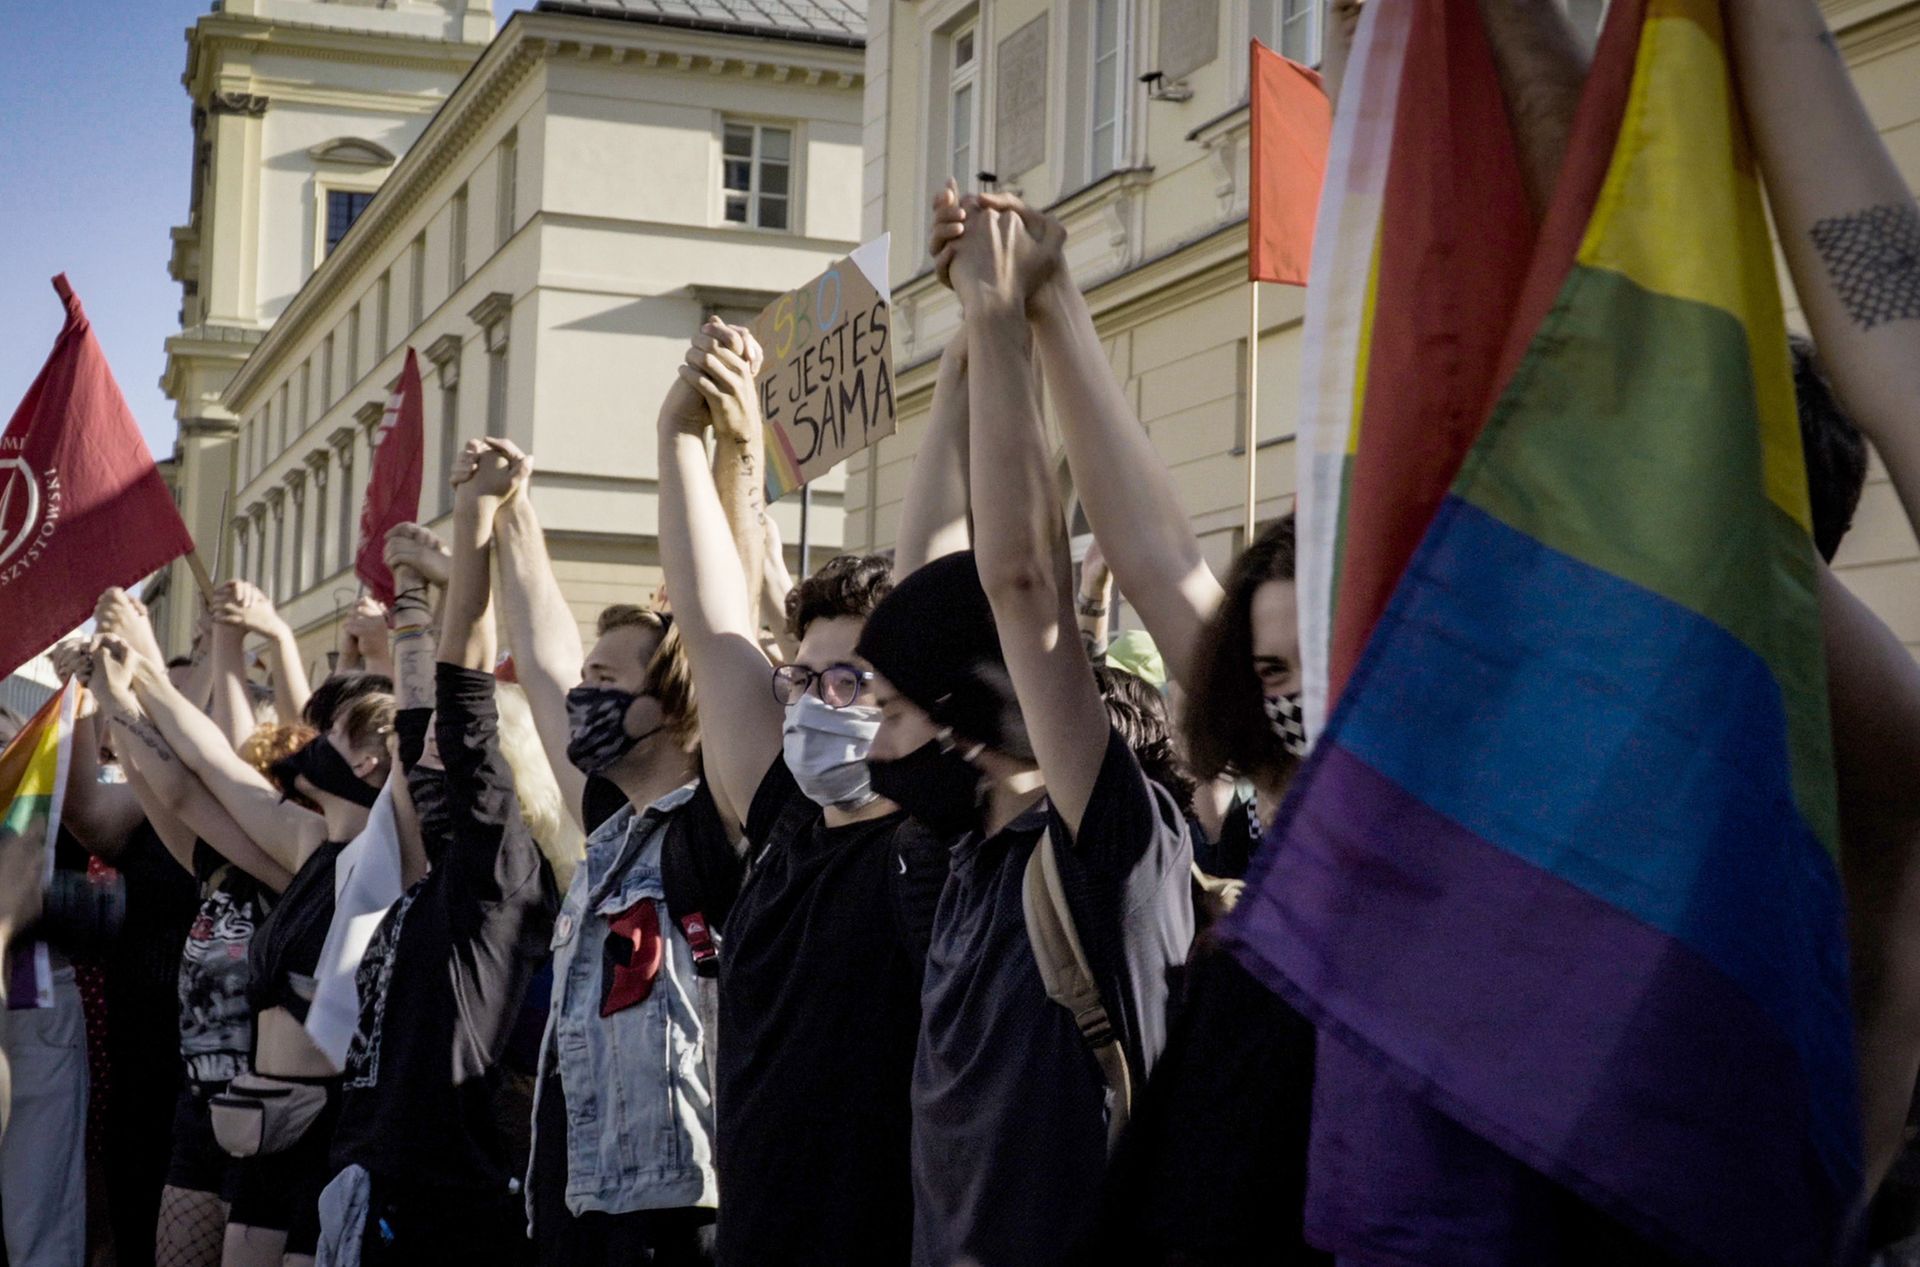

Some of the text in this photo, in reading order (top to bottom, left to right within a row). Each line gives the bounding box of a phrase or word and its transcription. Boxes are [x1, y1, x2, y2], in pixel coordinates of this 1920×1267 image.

[755, 270, 842, 373] ESBO
[760, 374, 781, 421] IE
[793, 356, 894, 466] SAMA
[0, 468, 61, 586] SZYSTOWSKI
